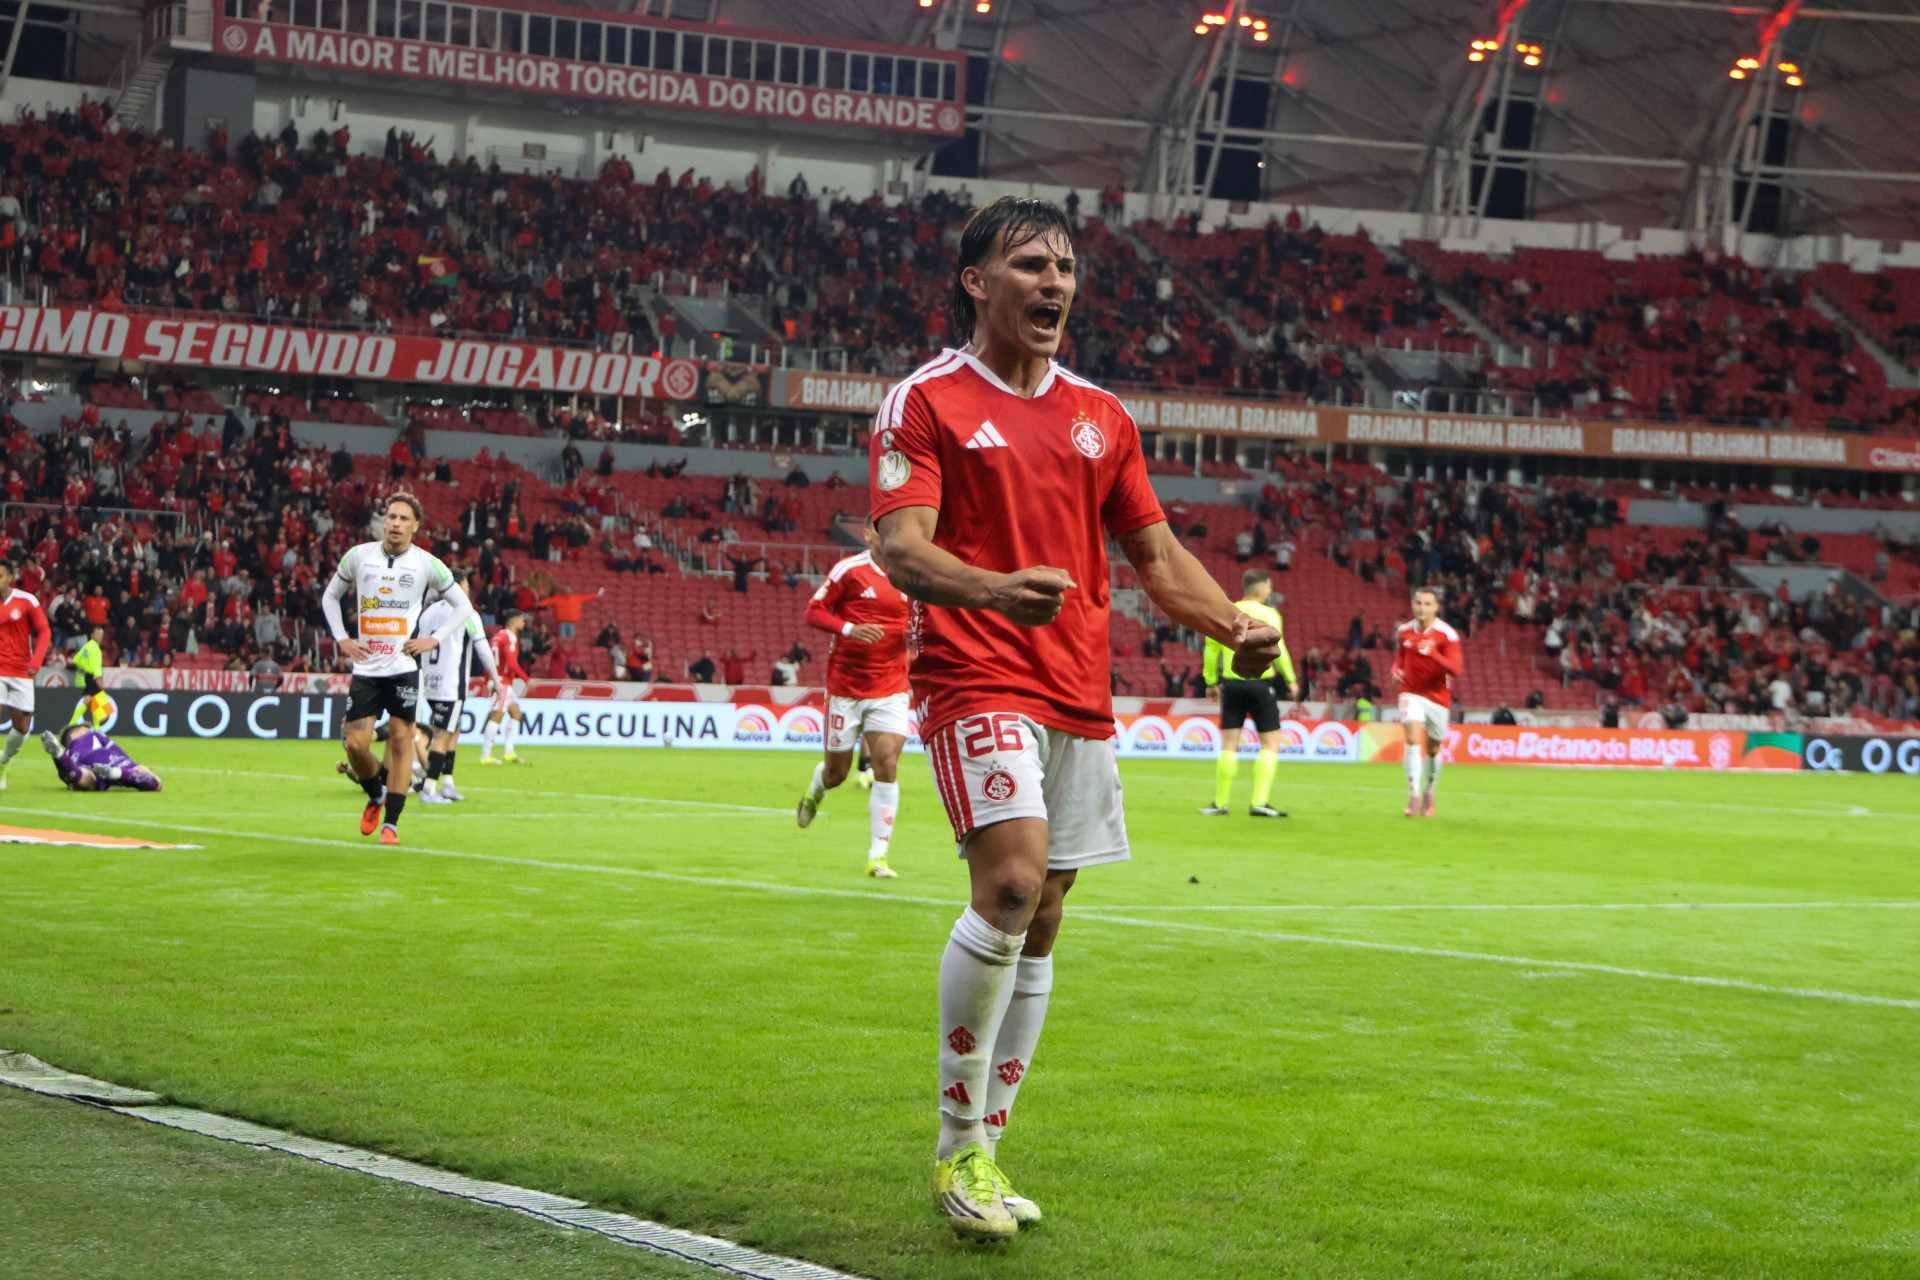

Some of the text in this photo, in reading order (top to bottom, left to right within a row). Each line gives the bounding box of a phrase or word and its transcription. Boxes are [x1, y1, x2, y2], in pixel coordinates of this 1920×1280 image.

[254, 27, 935, 130] A MAIOR E MELHOR TORCIDA DO RIO GRANDE
[138, 319, 396, 379] SEGUNDO
[415, 341, 661, 398] JOGADOR
[802, 377, 884, 410] BRAHMA
[1160, 401, 1237, 431] BRAHMA
[1241, 406, 1318, 437] BRAHMA
[1347, 414, 1584, 450] BRAHMA BRAHMA BRAHMA
[1612, 428, 1688, 455] BRAHMA
[1691, 431, 1766, 459] BRAHMA
[519, 710, 720, 739] MASCULINA
[733, 731, 771, 743] Aurora
[783, 732, 823, 744] Aurora
[831, 714, 844, 731] 10
[961, 713, 1024, 759] 26
[1467, 731, 1700, 763] Copa Betano do BRASIL
